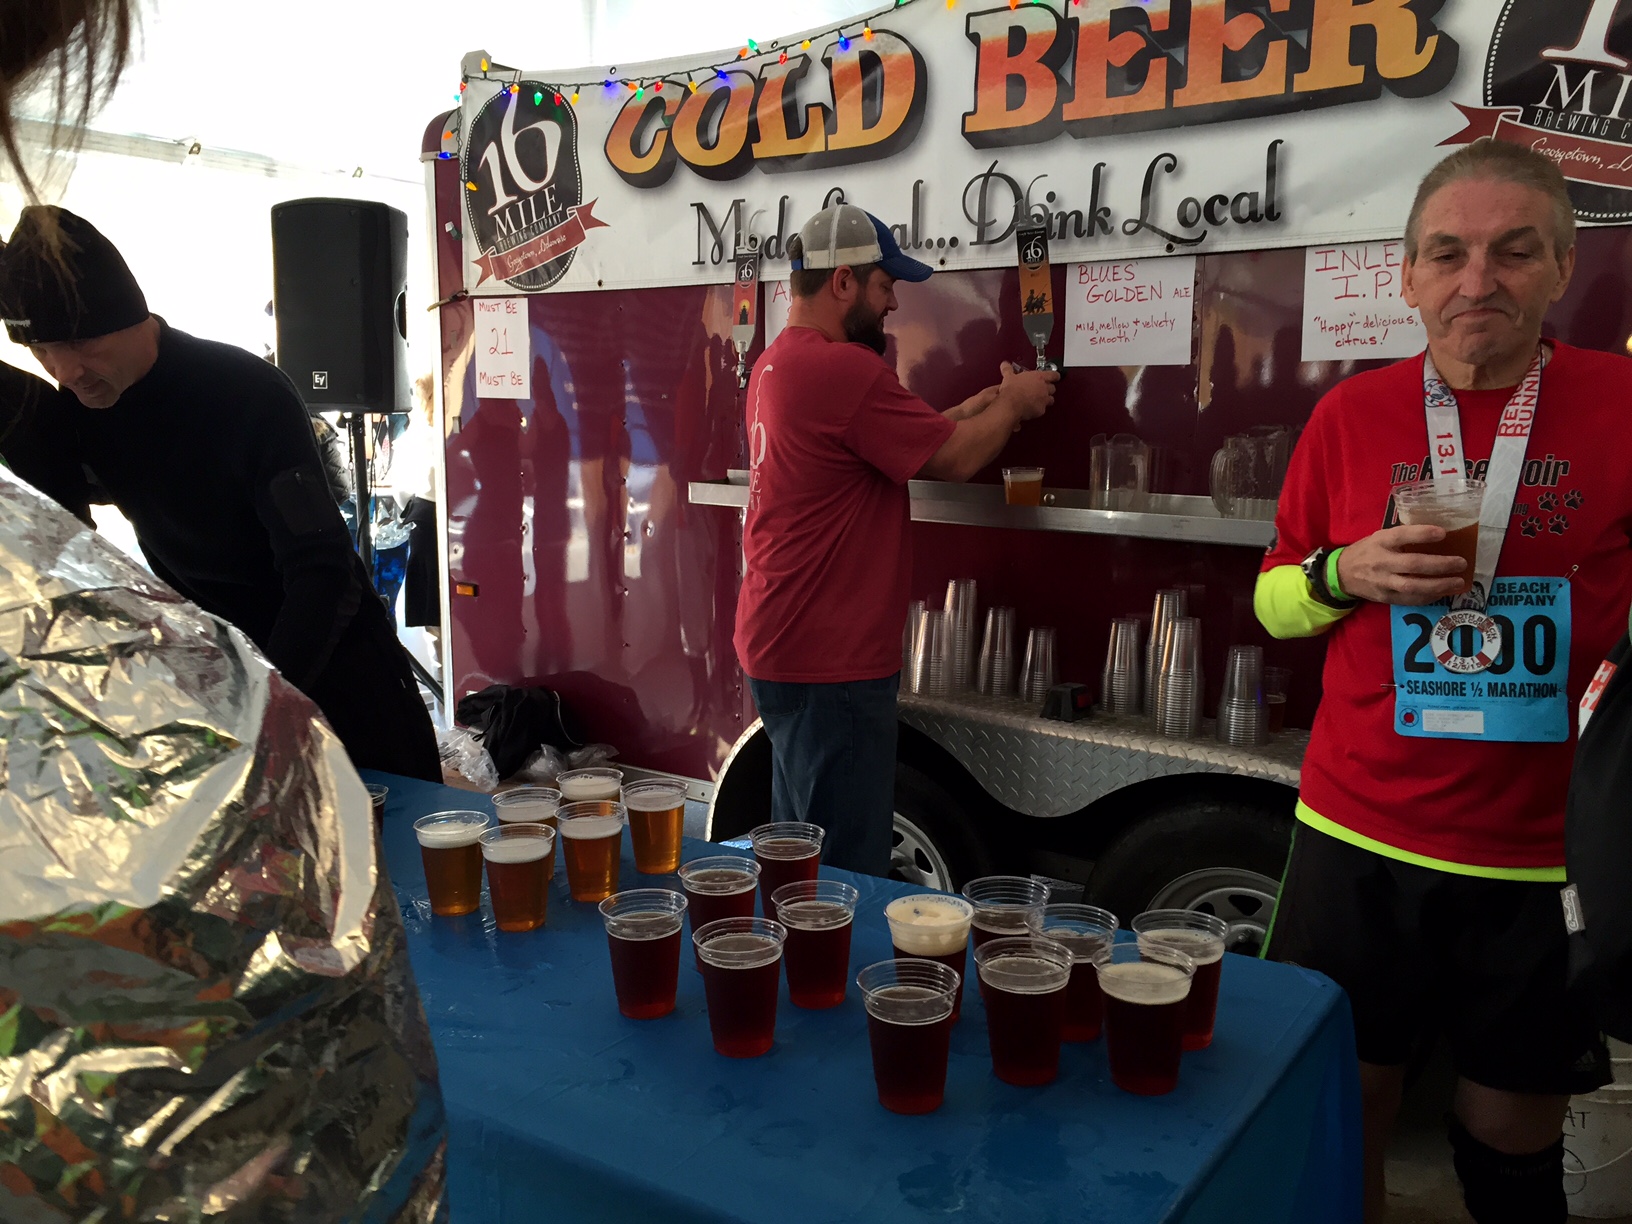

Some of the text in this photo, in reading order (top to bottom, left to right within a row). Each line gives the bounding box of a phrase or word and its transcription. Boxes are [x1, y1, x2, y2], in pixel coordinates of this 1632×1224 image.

[603, 0, 1460, 188] COLD BEER
[1533, 109, 1611, 136] BREWING
[477, 86, 562, 215] 16
[962, 160, 1114, 246] Dink
[1121, 139, 1284, 246] Local
[494, 183, 563, 243] MILE
[529, 212, 561, 236] COMPANY
[1025, 235, 1042, 259] 16
[1315, 243, 1400, 272] INLE
[740, 260, 753, 278] 16
[1086, 281, 1191, 304] GOLDEN ALE
[1332, 270, 1402, 300] I.P.
[505, 299, 517, 314] BE
[1142, 312, 1176, 332] velvety
[488, 327, 513, 355] 21
[1335, 328, 1388, 347] citrus!
[510, 370, 523, 386] BE
[1436, 432, 1458, 476] 13.1
[1390, 462, 1418, 484] The
[1496, 583, 1550, 594] BEACH
[1490, 595, 1557, 607] OMPANY
[1453, 656, 1475, 665] 13.1
[1406, 680, 1466, 697] SEASHORE
[1487, 682, 1557, 698] MARATHON
